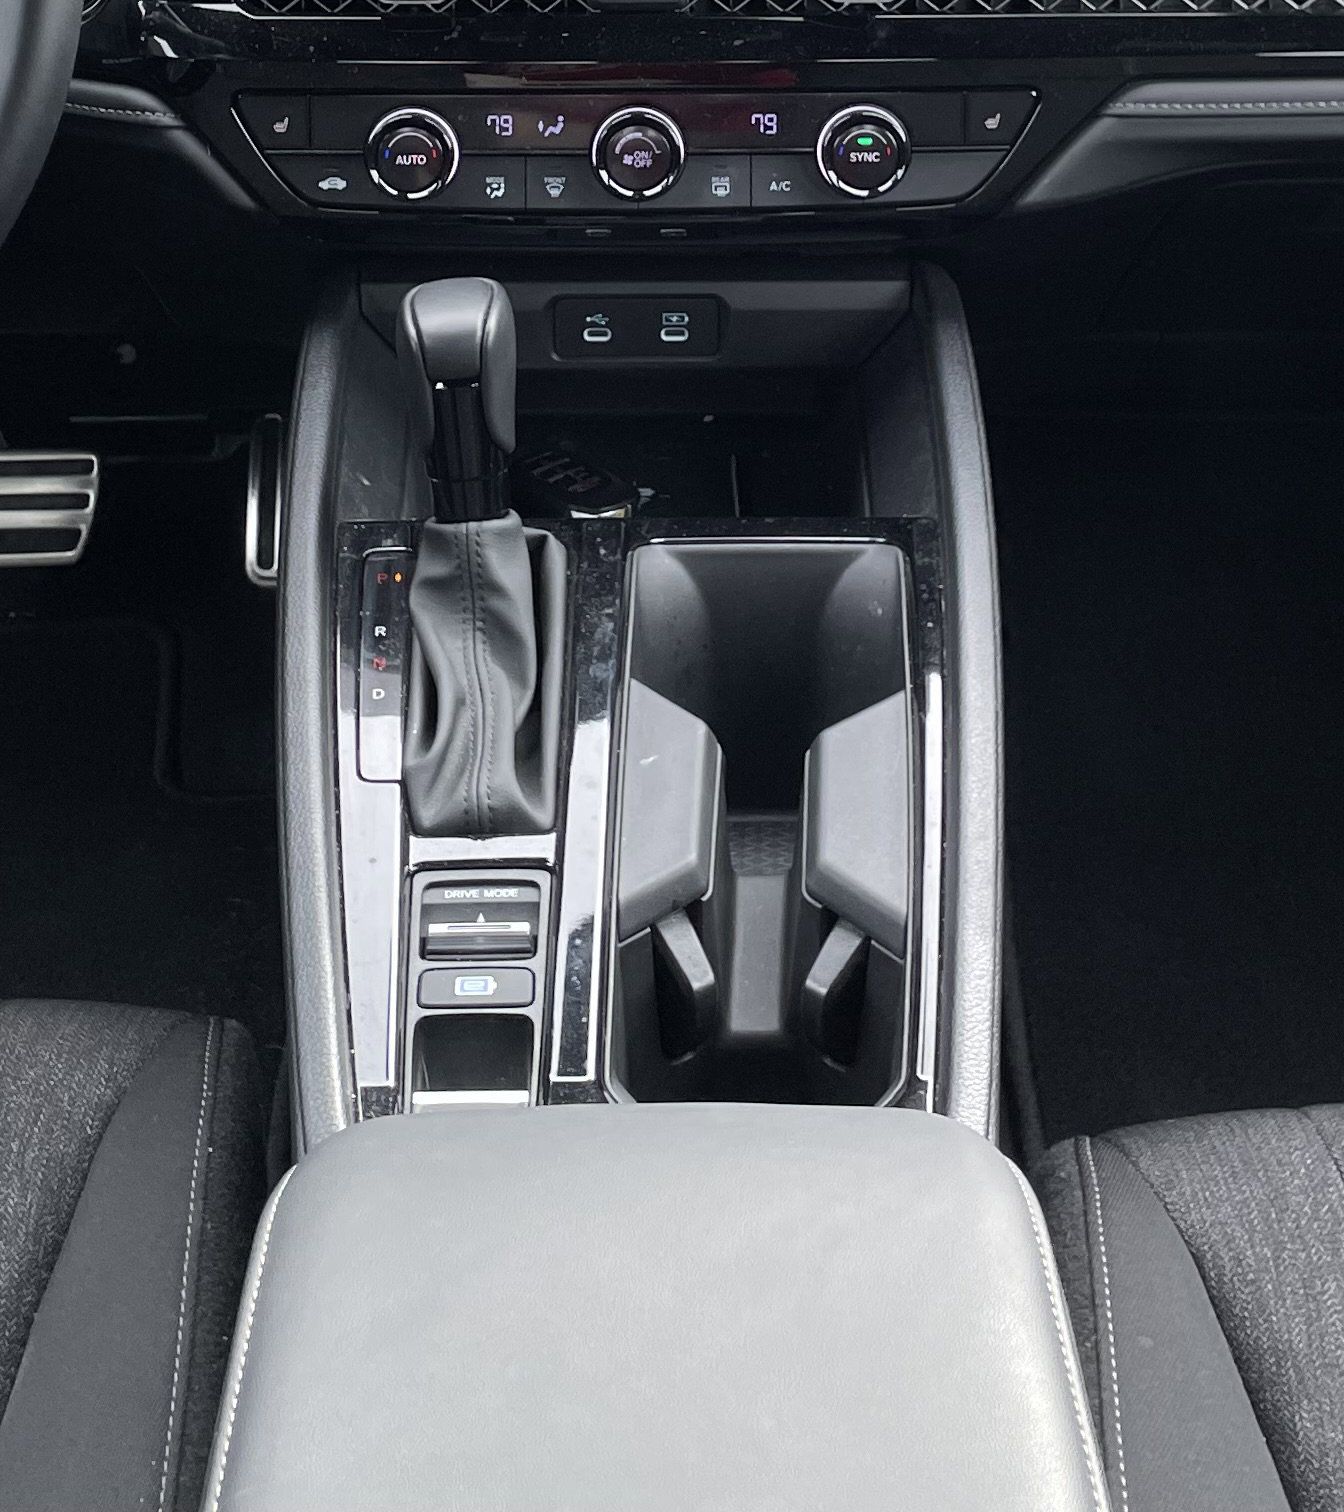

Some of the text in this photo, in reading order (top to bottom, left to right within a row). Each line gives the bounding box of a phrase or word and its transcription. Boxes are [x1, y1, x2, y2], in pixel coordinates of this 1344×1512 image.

[486, 114, 512, 136] 79
[751, 113, 777, 135] 79
[396, 155, 427, 166] AUTO
[849, 152, 880, 163] SYNC
[633, 159, 653, 168] OFF
[769, 180, 791, 192] A/C
[377, 573, 388, 585] P
[374, 626, 387, 637] R
[372, 658, 386, 669] N
[372, 688, 385, 700] D
[444, 889, 519, 899] DRIVE MODE
